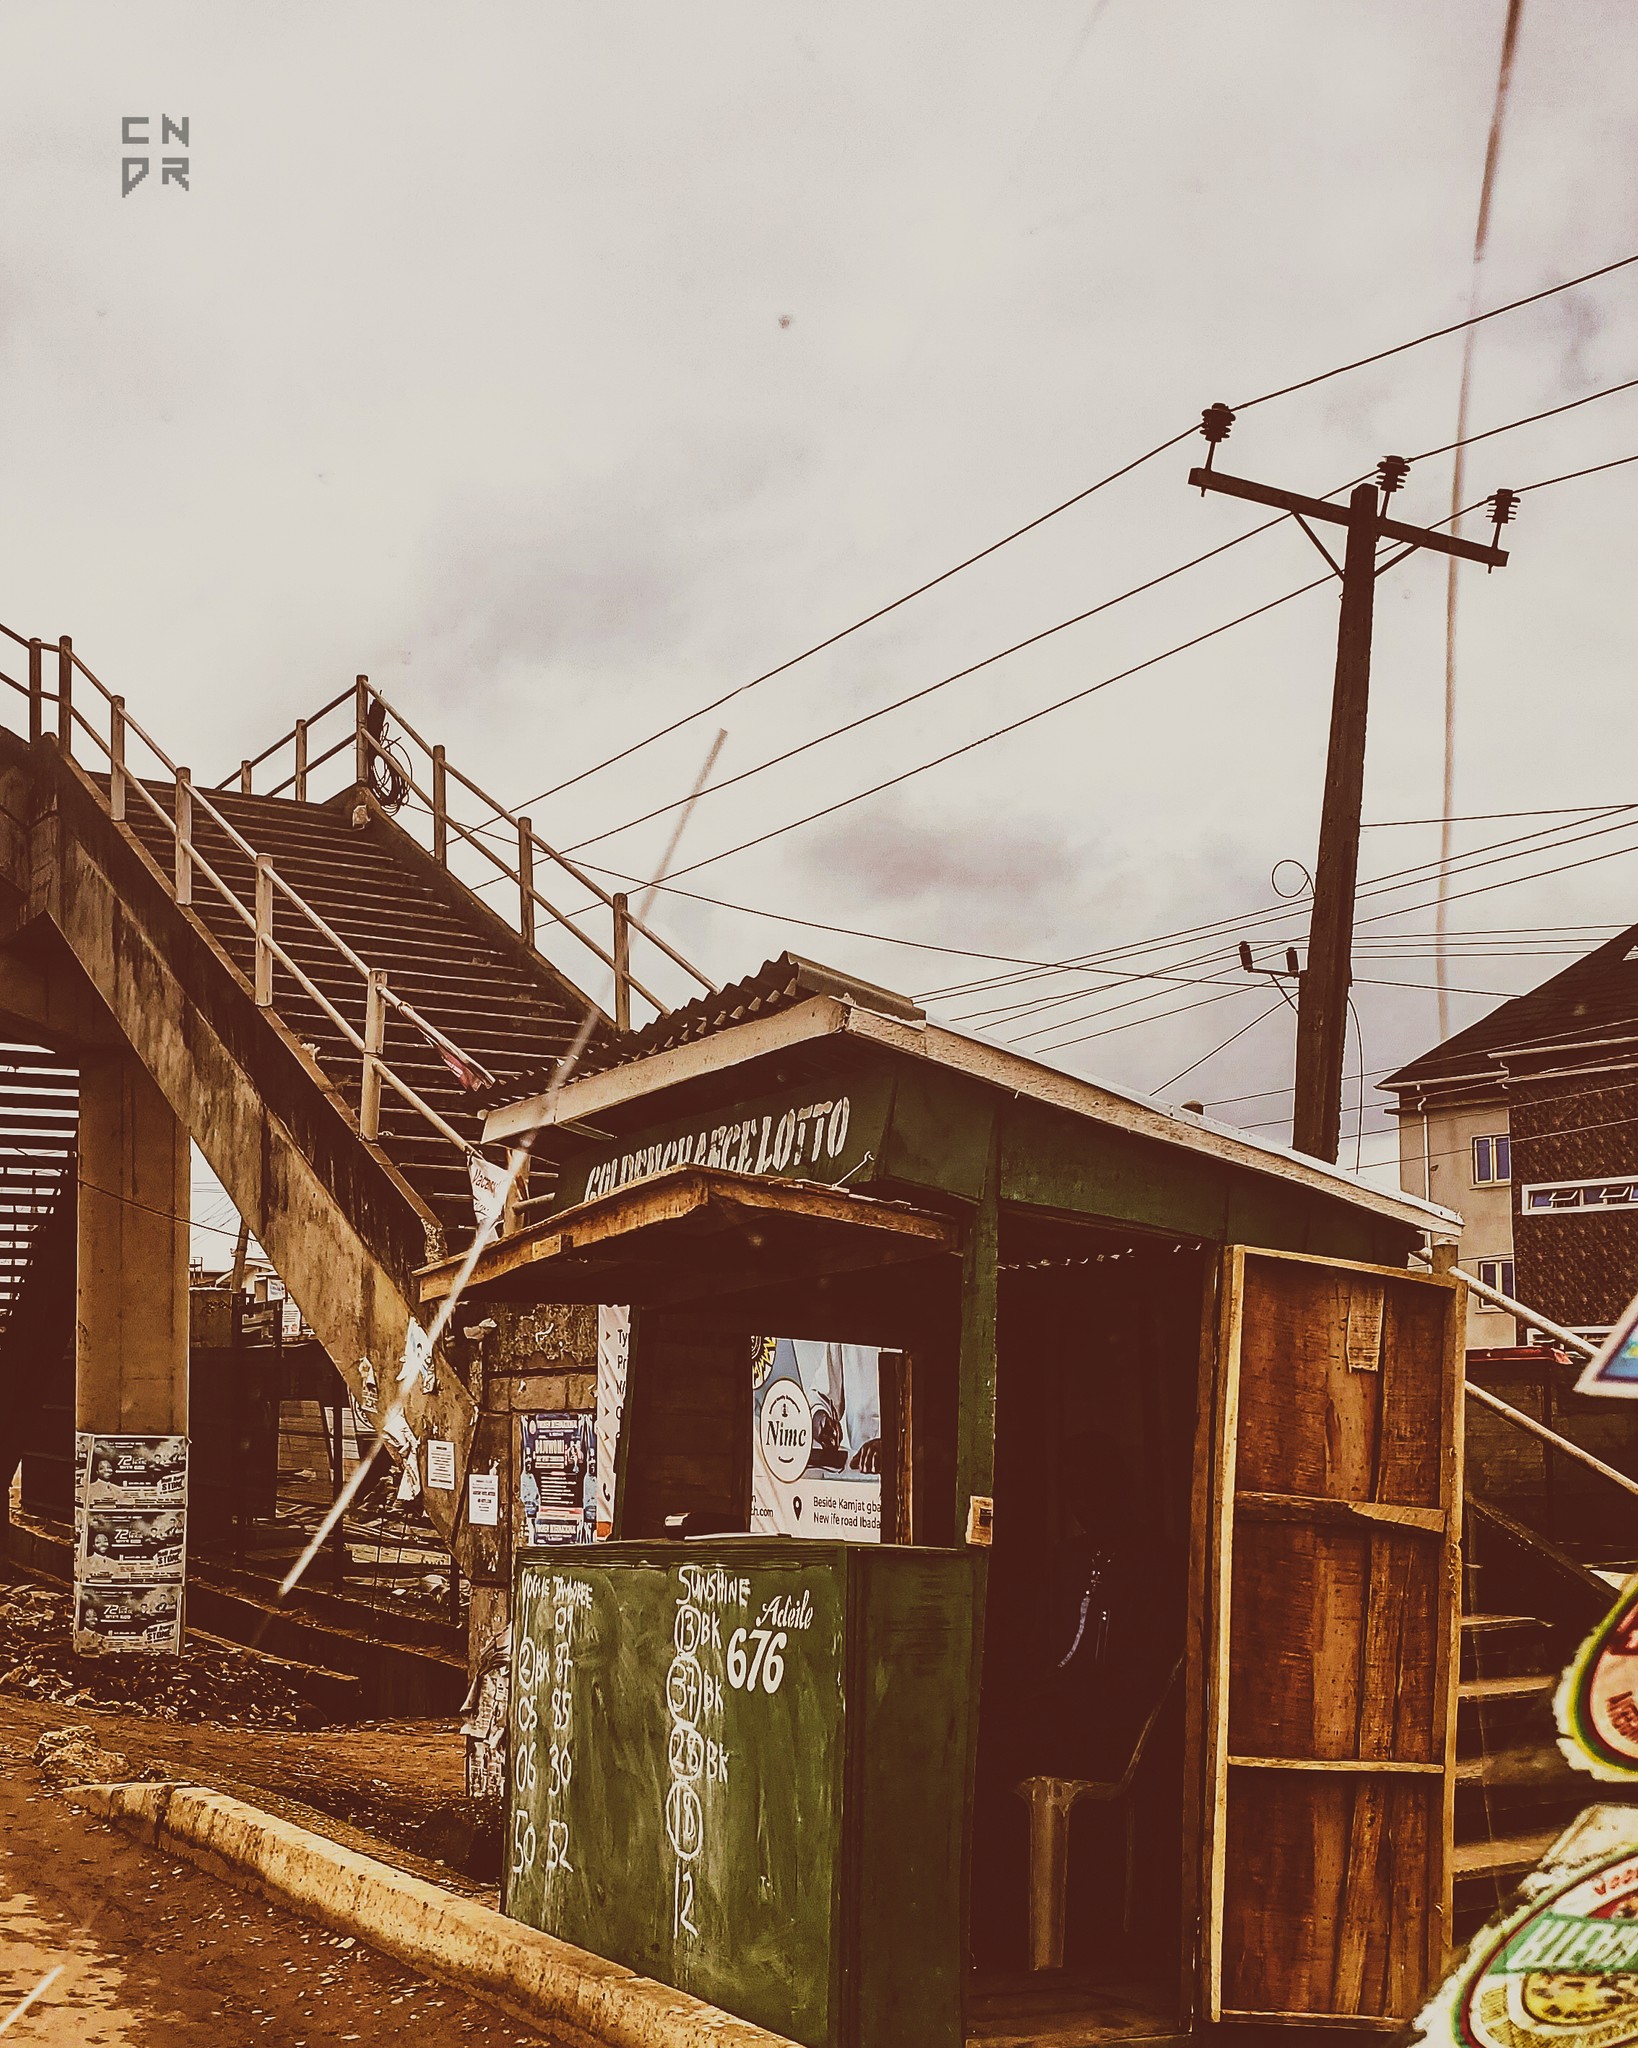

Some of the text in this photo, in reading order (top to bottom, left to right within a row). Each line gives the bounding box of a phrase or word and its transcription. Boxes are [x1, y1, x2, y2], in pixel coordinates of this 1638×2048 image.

[754, 1096, 850, 1174] LOTTO
[766, 1420, 806, 1447] Nimc
[813, 1496, 837, 1508] Beside
[838, 1499, 865, 1513] Kamjat
[813, 1512, 829, 1524] New
[841, 1516, 858, 1527] road
[676, 1565, 751, 1608] SUNSHINE
[727, 1627, 788, 1694] 676
[515, 1742, 572, 1797] 06 30
[512, 1809, 536, 1873] 50
